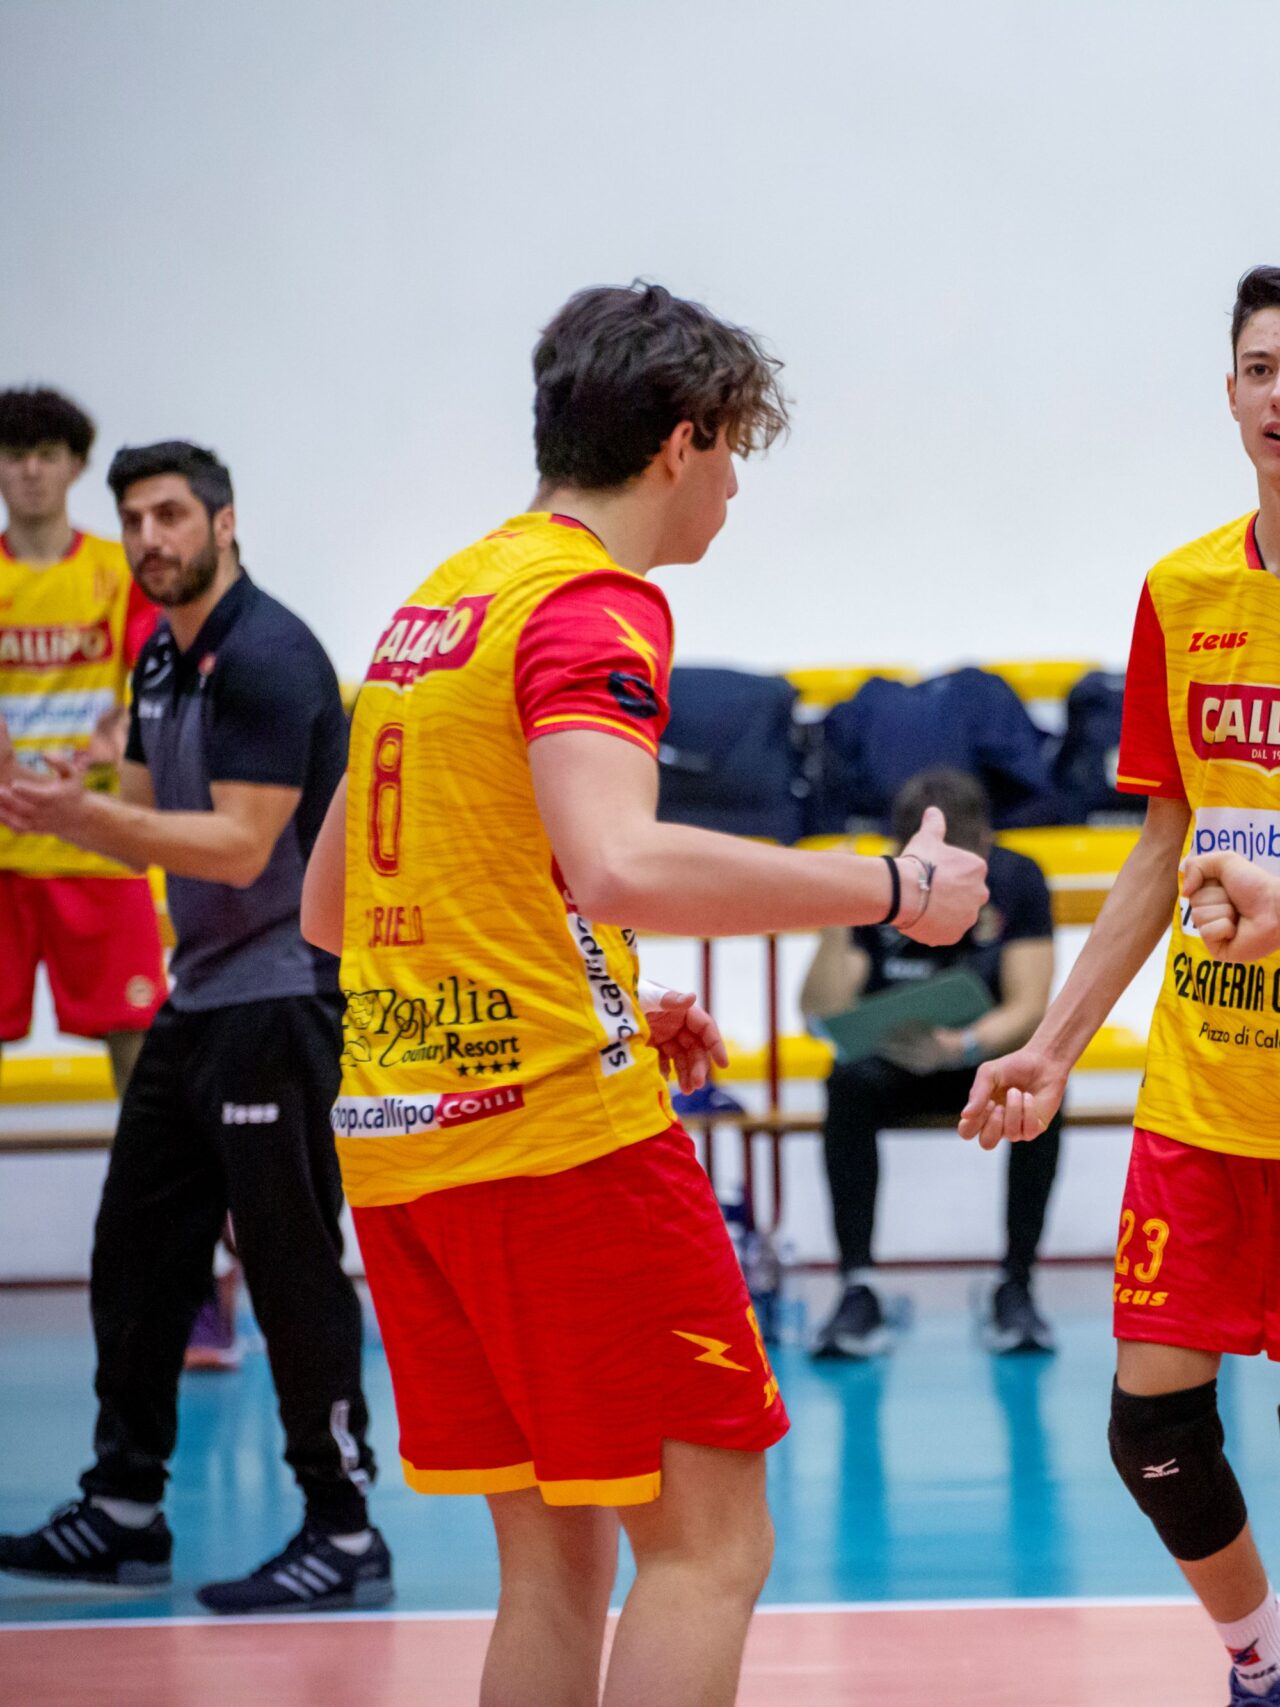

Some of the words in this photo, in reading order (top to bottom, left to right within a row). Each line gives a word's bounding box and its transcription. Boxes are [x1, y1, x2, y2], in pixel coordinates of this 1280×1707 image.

[0, 623, 106, 663] ALLIPO
[1251, 748, 1268, 760] DAL
[445, 1032, 521, 1061] Resort
[1199, 1021, 1230, 1044] Pizzo
[1234, 1025, 1250, 1046] di
[1116, 1208, 1170, 1283] 23
